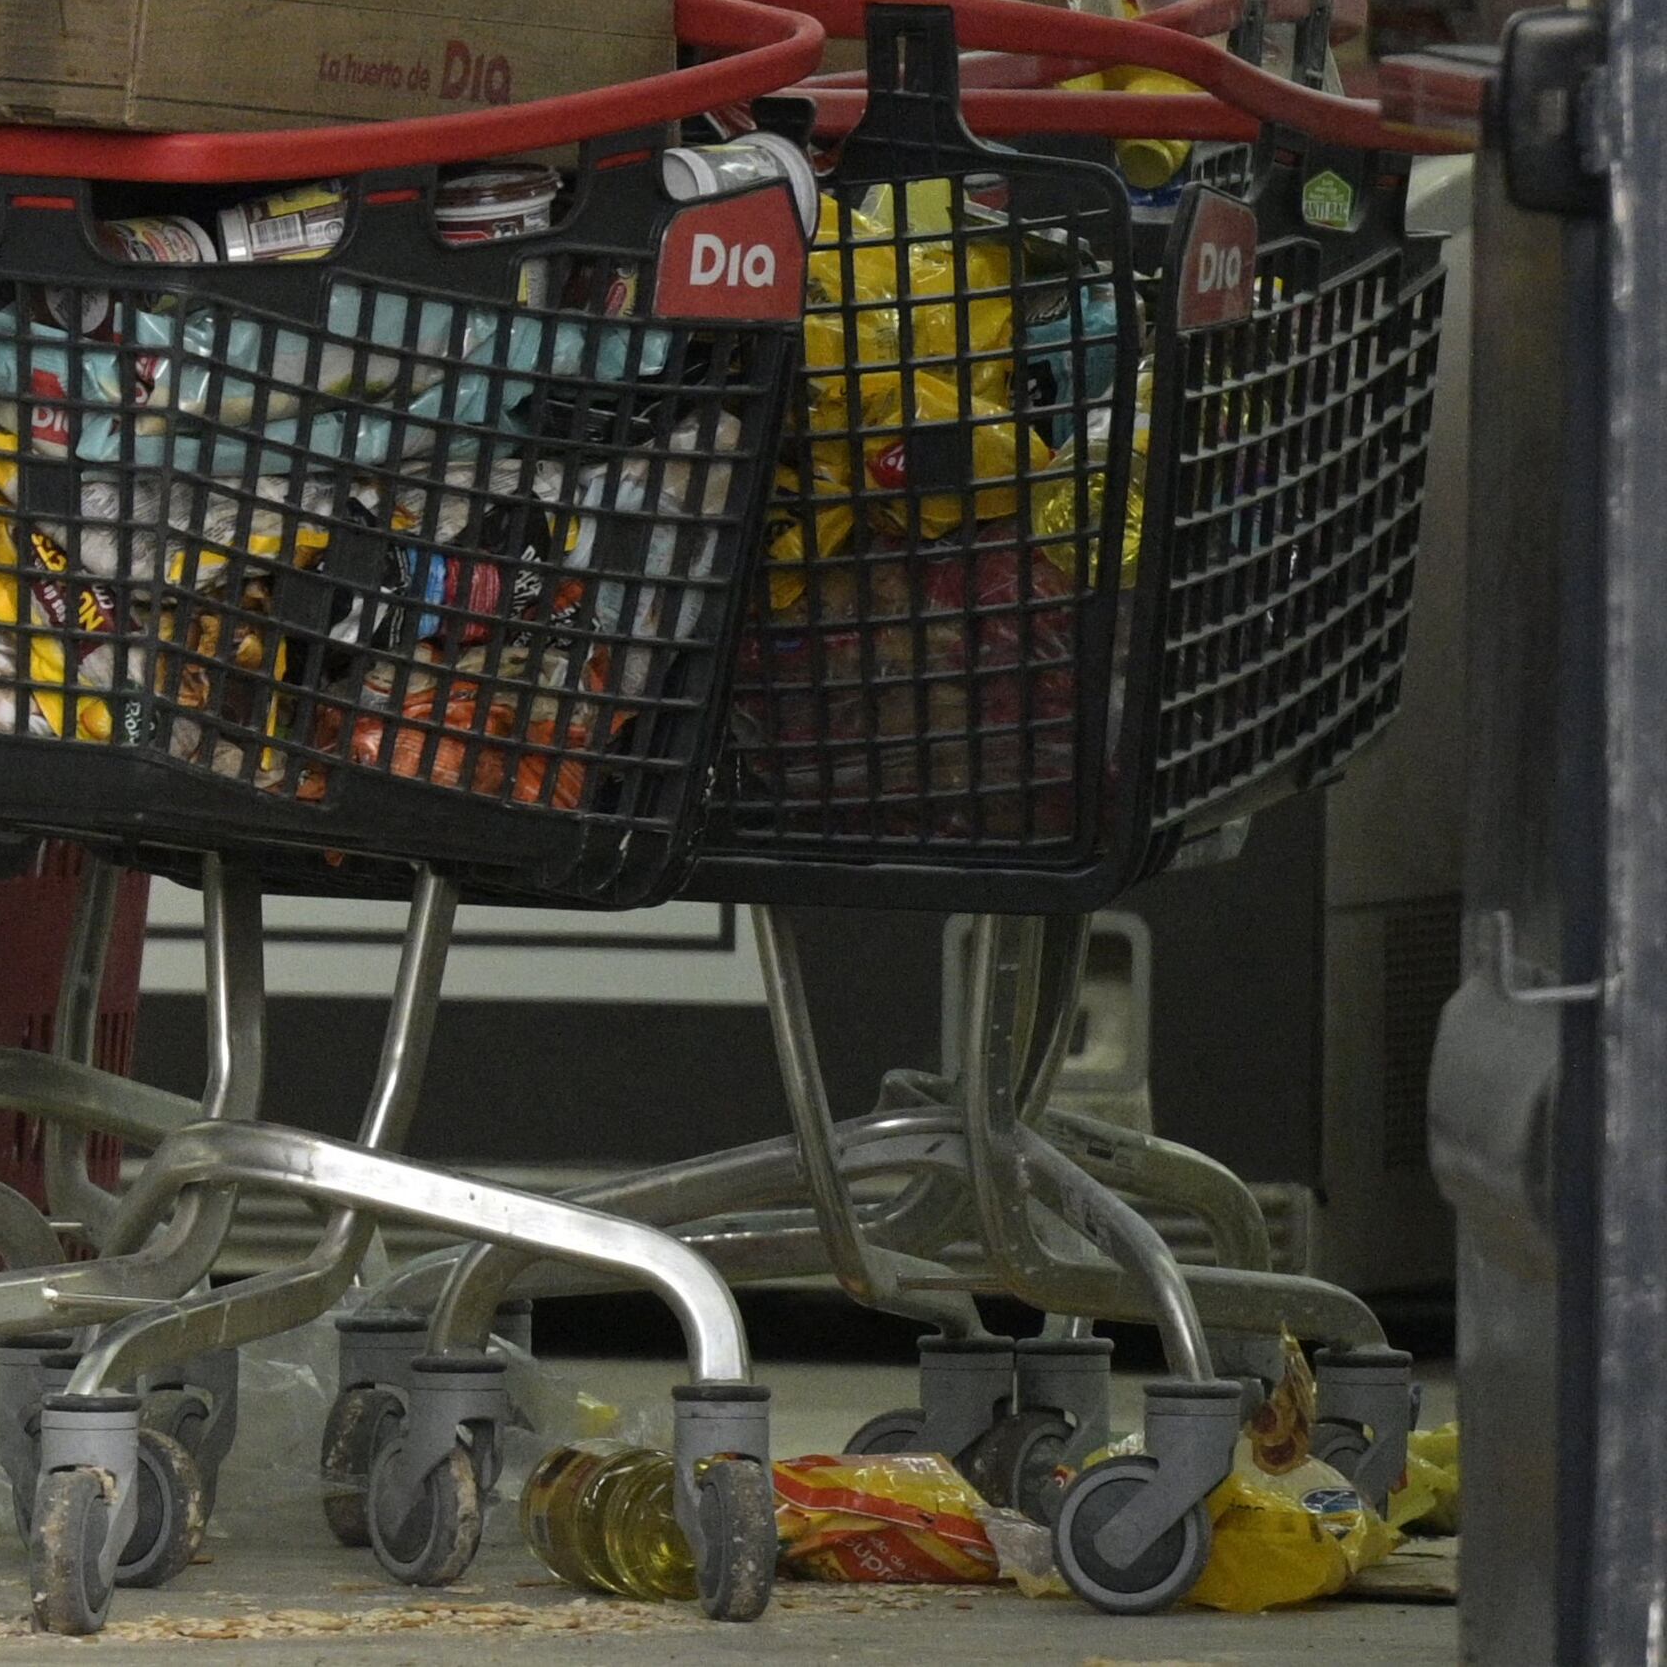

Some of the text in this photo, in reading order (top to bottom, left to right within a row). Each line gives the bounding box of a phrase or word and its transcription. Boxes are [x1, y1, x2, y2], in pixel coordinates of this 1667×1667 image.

[319, 52, 340, 84] La
[407, 61, 431, 92] de
[31, 406, 69, 433] Di
